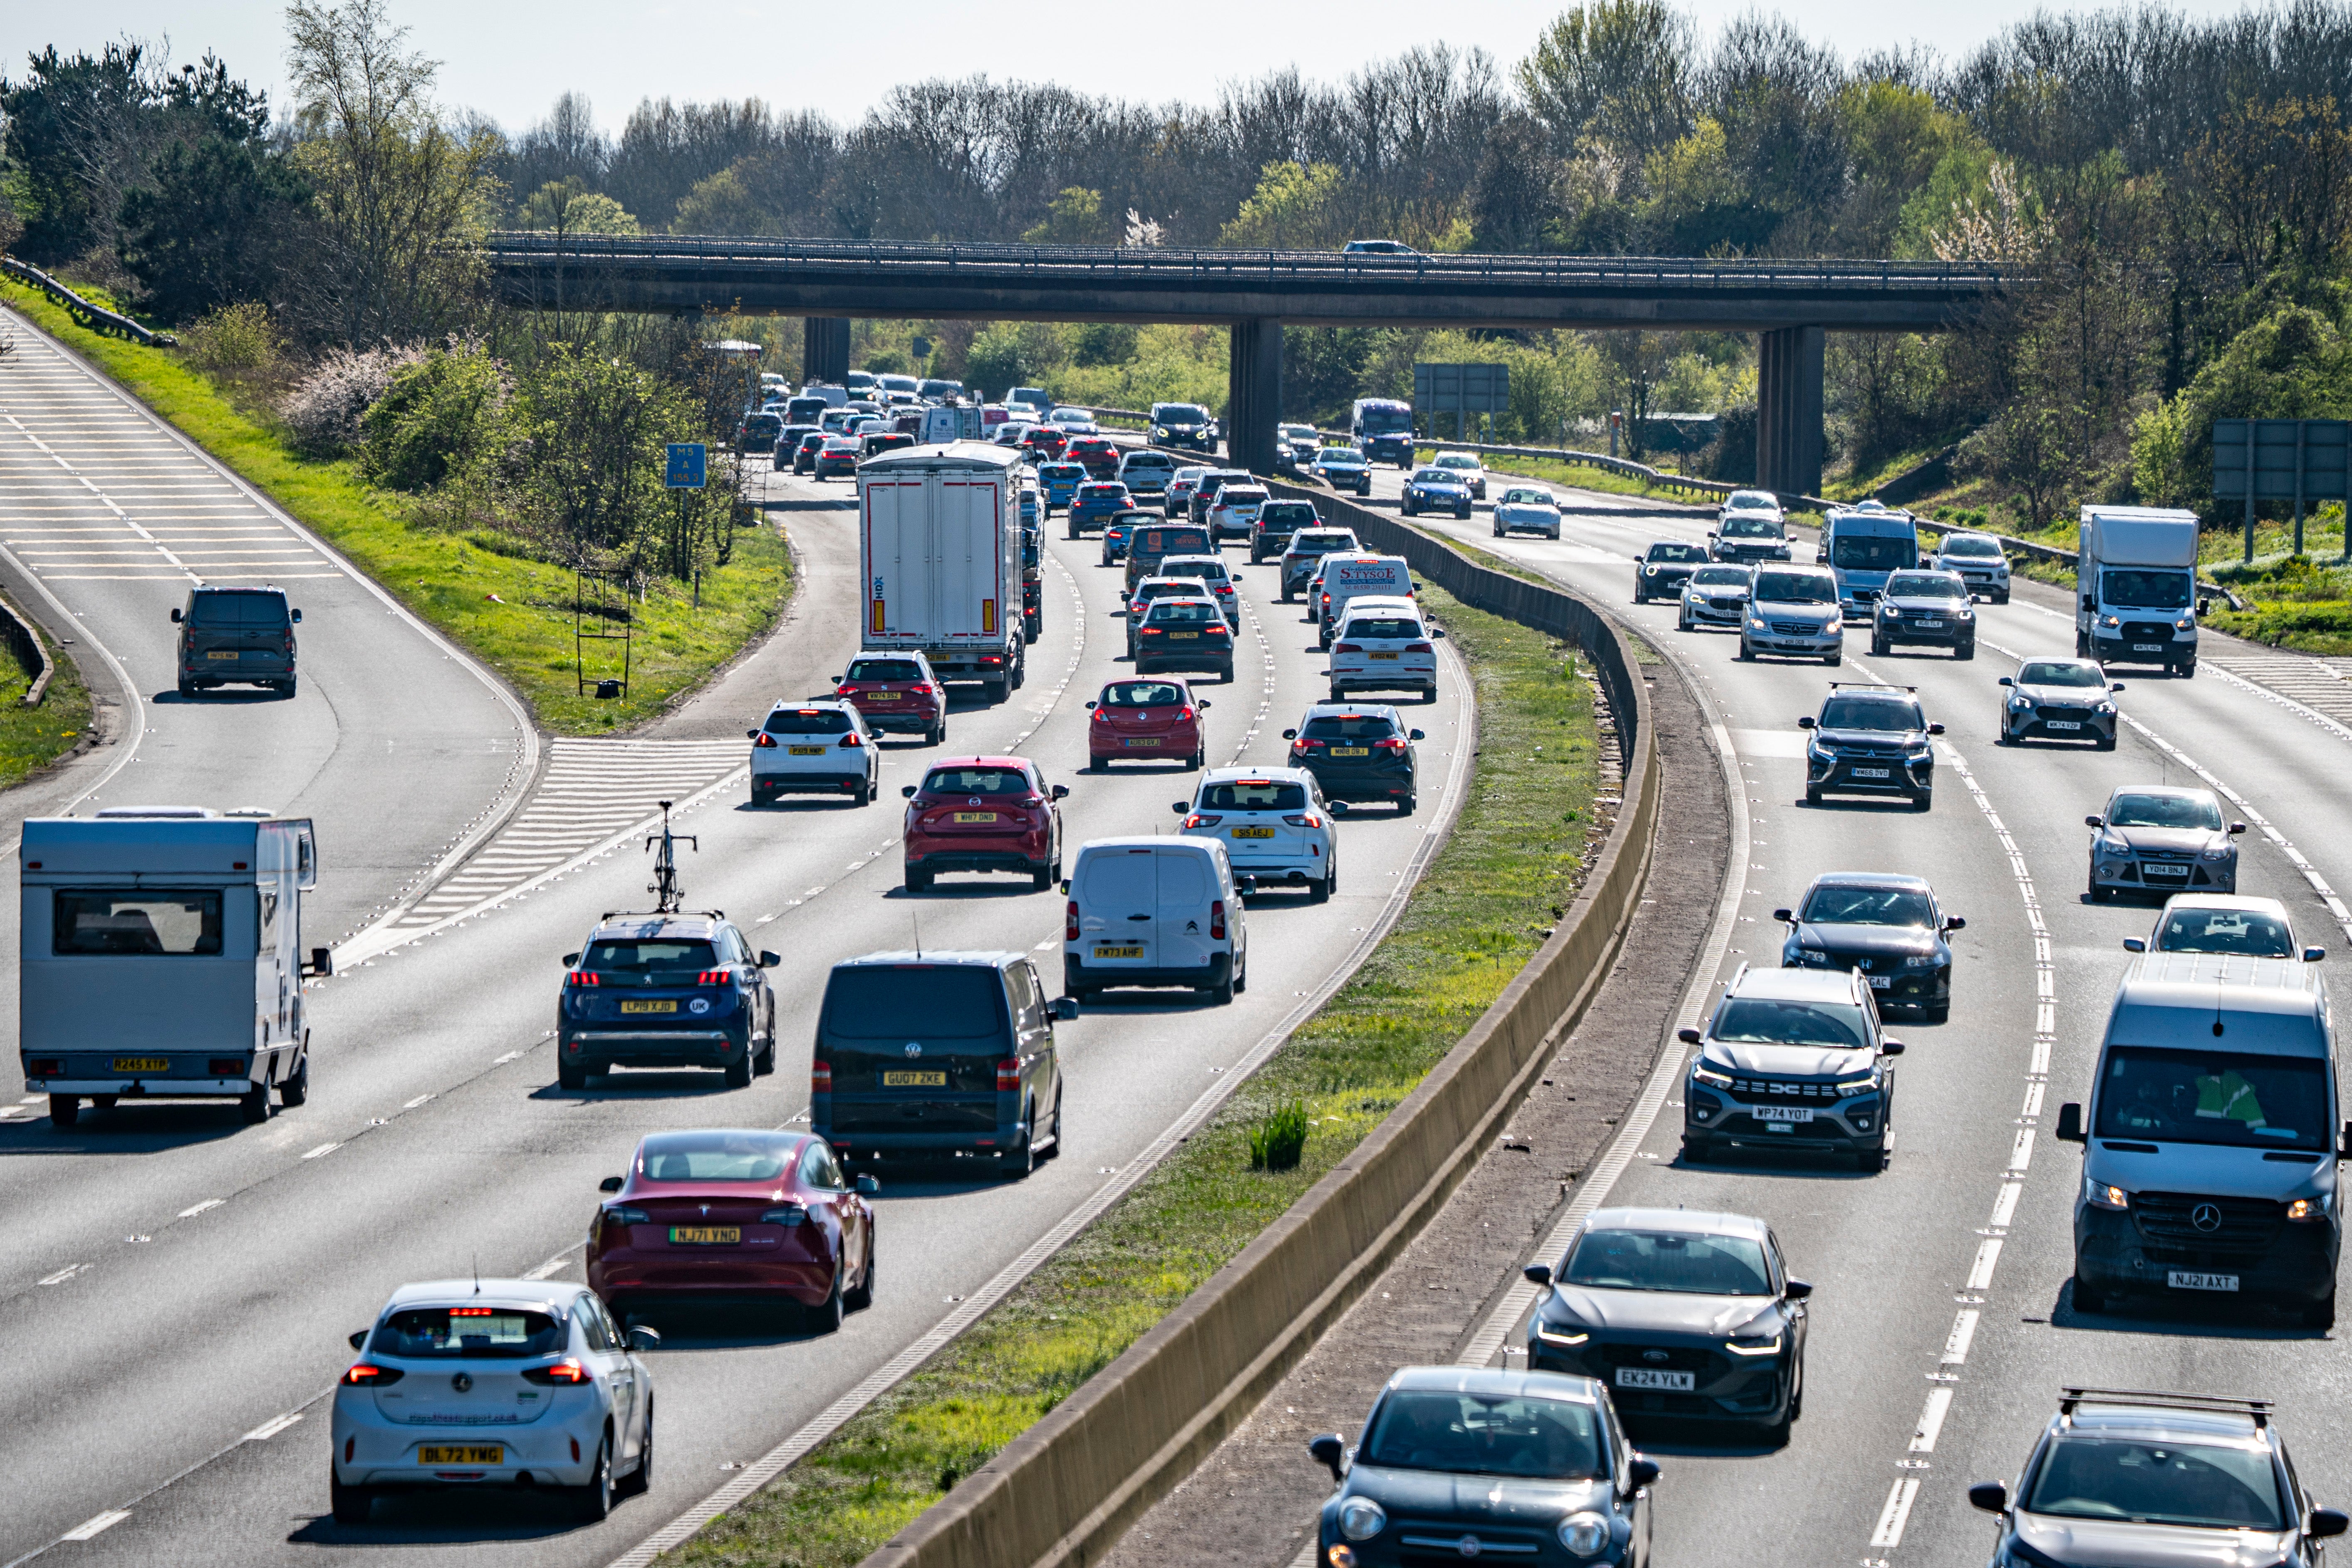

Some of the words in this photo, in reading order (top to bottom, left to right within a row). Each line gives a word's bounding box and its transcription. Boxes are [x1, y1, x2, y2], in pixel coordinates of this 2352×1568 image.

[683, 461, 689, 469] A
[1870, 978, 1887, 987] GAC
[627, 1002, 649, 1011] LP19
[114, 1060, 141, 1069] R245
[145, 1060, 166, 1069] XTP
[889, 1073, 916, 1084] GU07
[920, 1073, 941, 1084] ZKE
[1758, 1107, 1785, 1119] WP74
[1789, 1109, 1809, 1120] YOT
[678, 1230, 707, 1241] NJ71
[2175, 1273, 2203, 1286] NJ21
[2206, 1274, 2231, 1288] AXT
[1622, 1371, 1657, 1386] EK24
